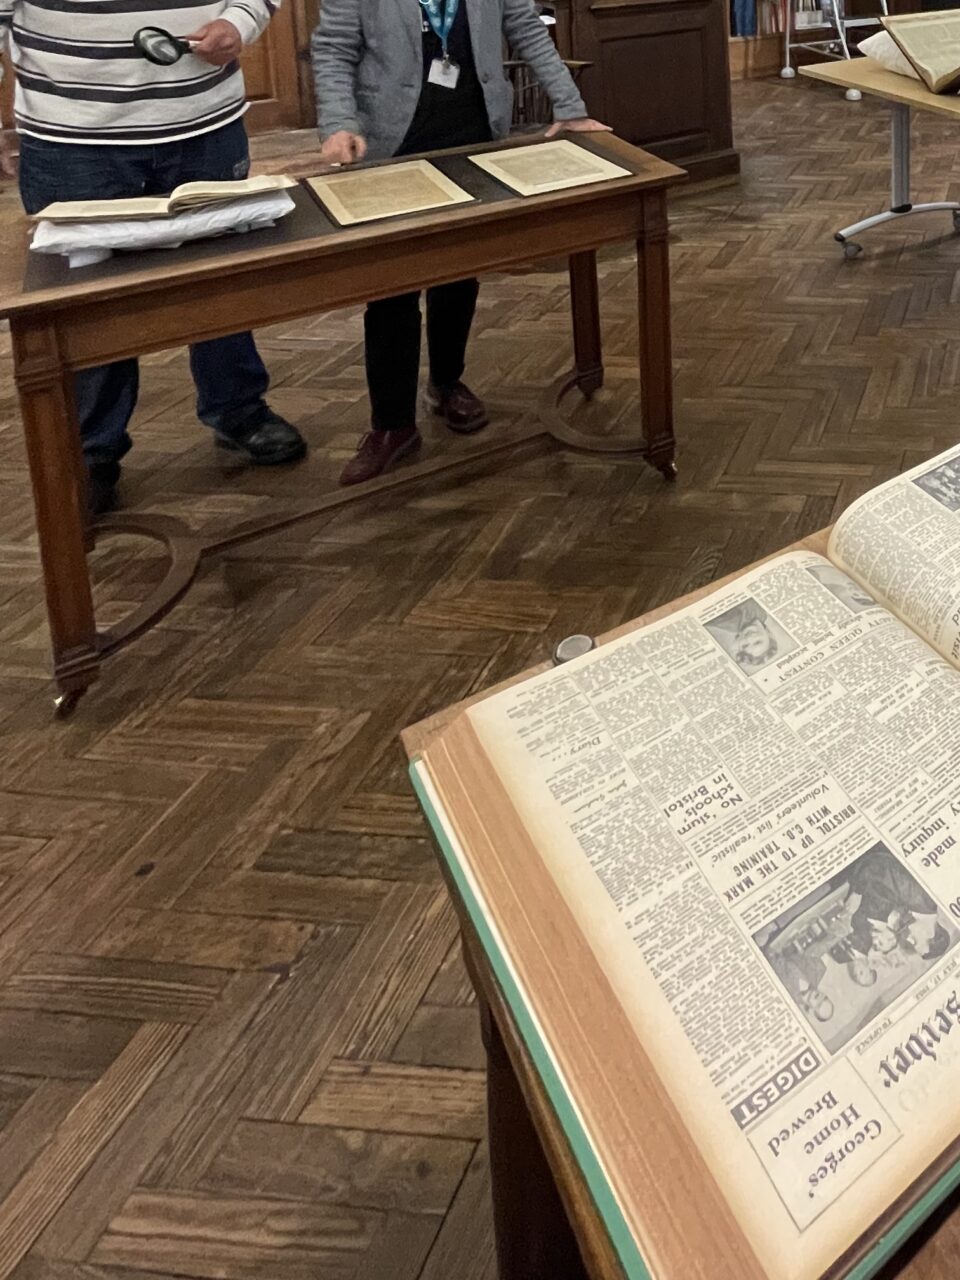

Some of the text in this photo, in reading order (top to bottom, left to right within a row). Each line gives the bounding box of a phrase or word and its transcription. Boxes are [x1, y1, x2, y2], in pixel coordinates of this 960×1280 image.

[828, 625, 863, 652] QUEEN
[777, 650, 825, 682] CONTEST
[662, 772, 727, 817] in Bristol
[719, 792, 743, 812] No
[730, 804, 831, 877] WITH C.D. TRAINING
[755, 819, 774, 835] list
[896, 815, 947, 860] inquiry
[721, 803, 856, 902] BRISTOL UP TO THE MARK
[919, 834, 959, 872] made
[731, 1050, 817, 1125] DIGEST
[764, 1089, 839, 1157] Brewed
[800, 1102, 862, 1159] Home
